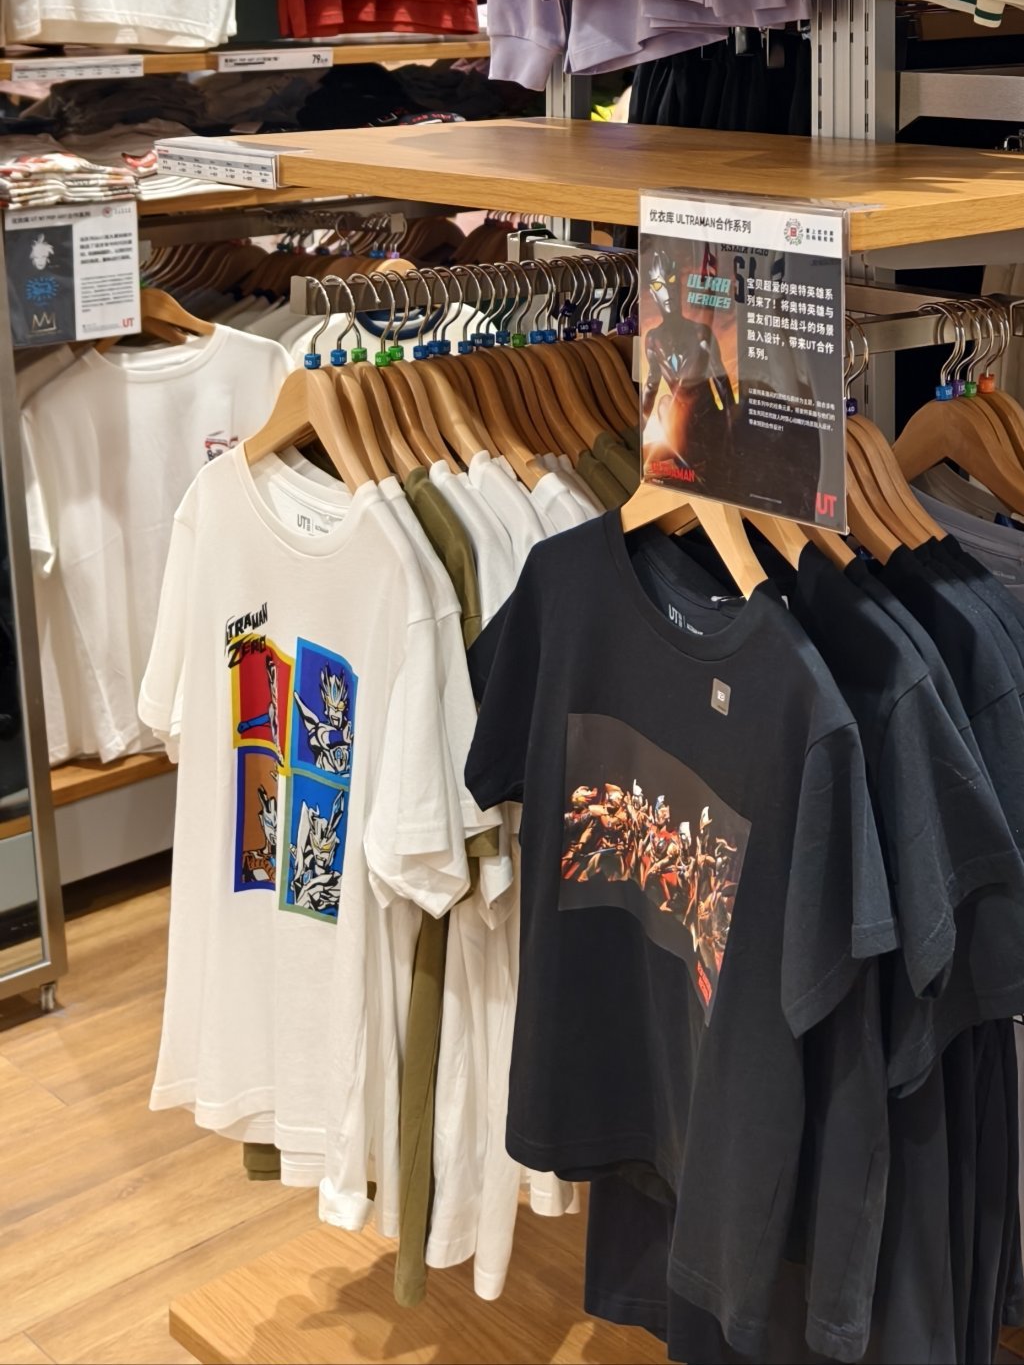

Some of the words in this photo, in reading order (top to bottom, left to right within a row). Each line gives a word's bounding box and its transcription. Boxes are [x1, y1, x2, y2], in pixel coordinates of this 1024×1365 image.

[650, 209, 674, 224] 优衣库
[687, 274, 731, 293] ULTRA
[747, 278, 833, 300] 宝贝超爱的奥特英雄系
[687, 292, 731, 309] HEROES
[122, 317, 135, 328] UT
[747, 312, 834, 336] 盟友们团结战斗的场景
[816, 492, 837, 518] UT
